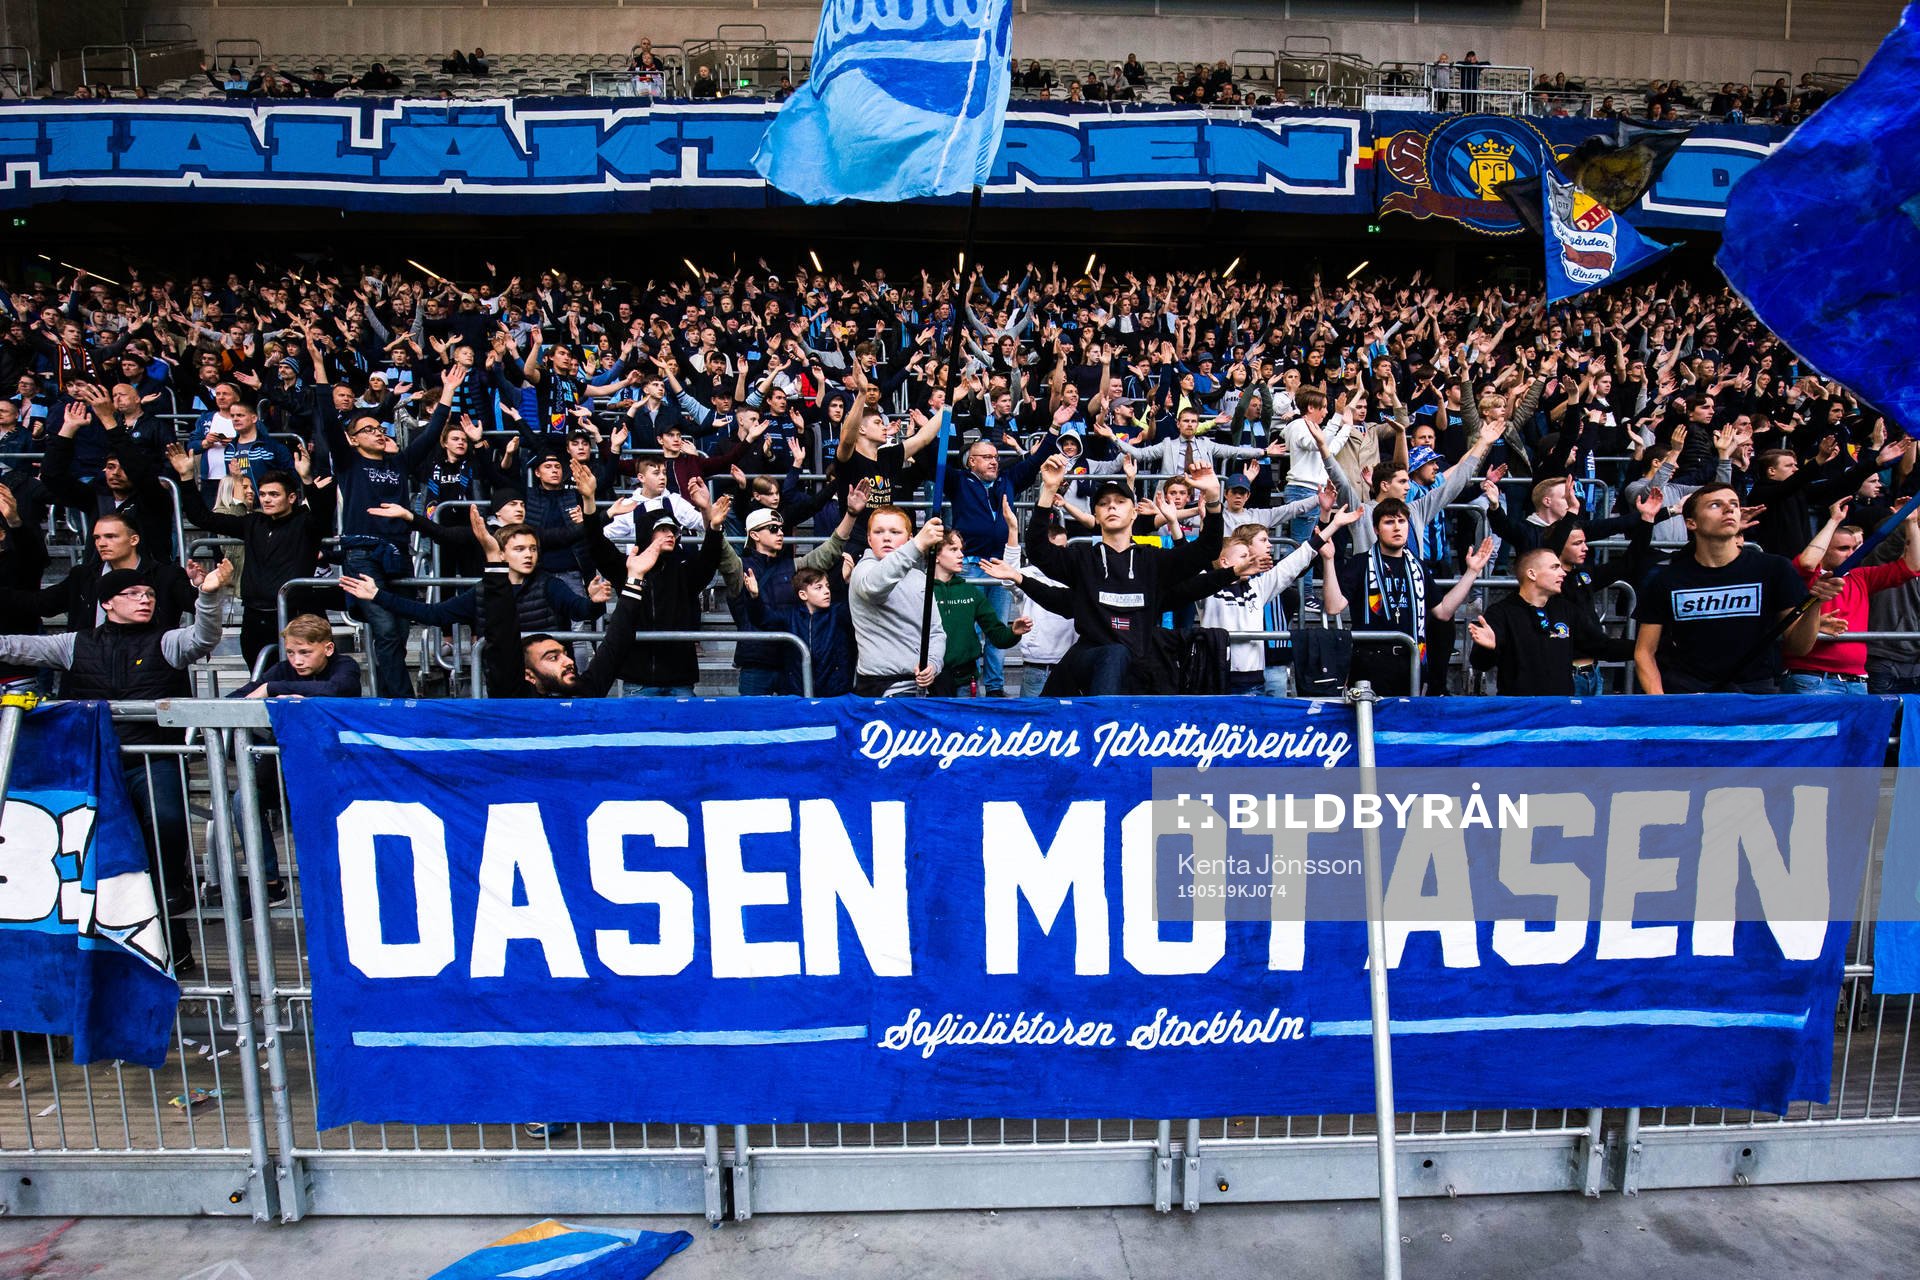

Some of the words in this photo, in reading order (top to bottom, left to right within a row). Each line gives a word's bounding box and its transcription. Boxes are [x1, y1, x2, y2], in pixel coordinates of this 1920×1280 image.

[0, 108, 1348, 190] IALÄKTREN
[1681, 594, 1752, 613] sthlm
[860, 719, 1080, 769] Djurgårdens
[1093, 721, 1352, 769] Idrottsförening
[336, 798, 913, 979] OASEN
[982, 799, 1340, 977] MOT
[1363, 784, 1830, 970] ASEN
[877, 1008, 1116, 1059] Sofialäktaren
[1126, 1007, 1305, 1051] Stockholm
